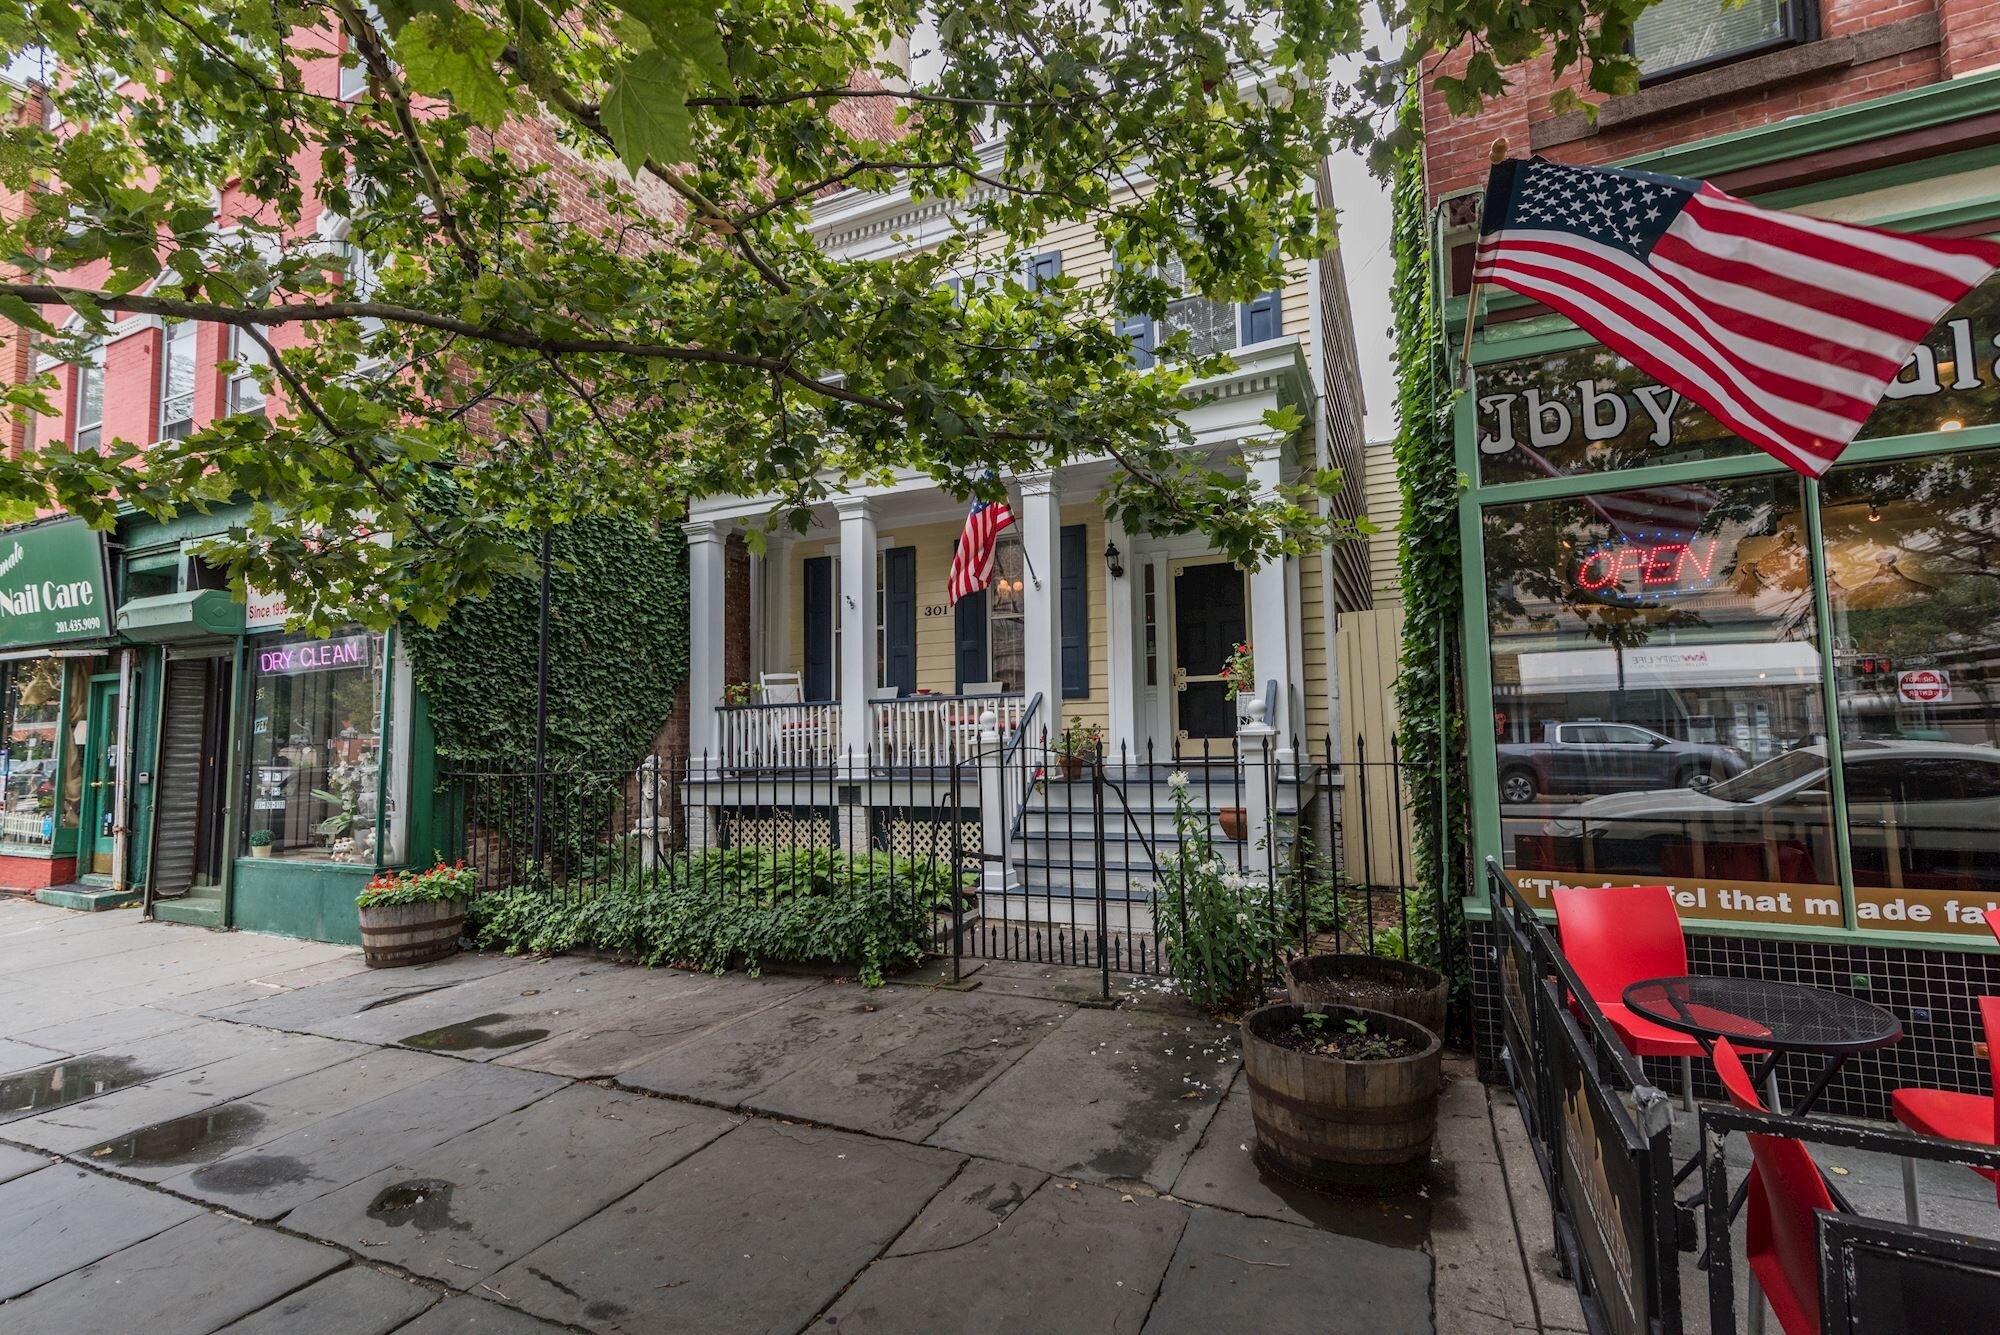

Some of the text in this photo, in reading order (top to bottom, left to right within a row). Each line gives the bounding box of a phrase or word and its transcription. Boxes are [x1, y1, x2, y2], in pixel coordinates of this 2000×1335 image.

[1579, 540, 1718, 590] OPEN
[0, 580, 94, 618] Nail Care
[249, 604, 270, 619] Since
[924, 605, 948, 617] 301
[261, 641, 359, 672] DRY CLEAN
[1718, 889, 1792, 914] that
